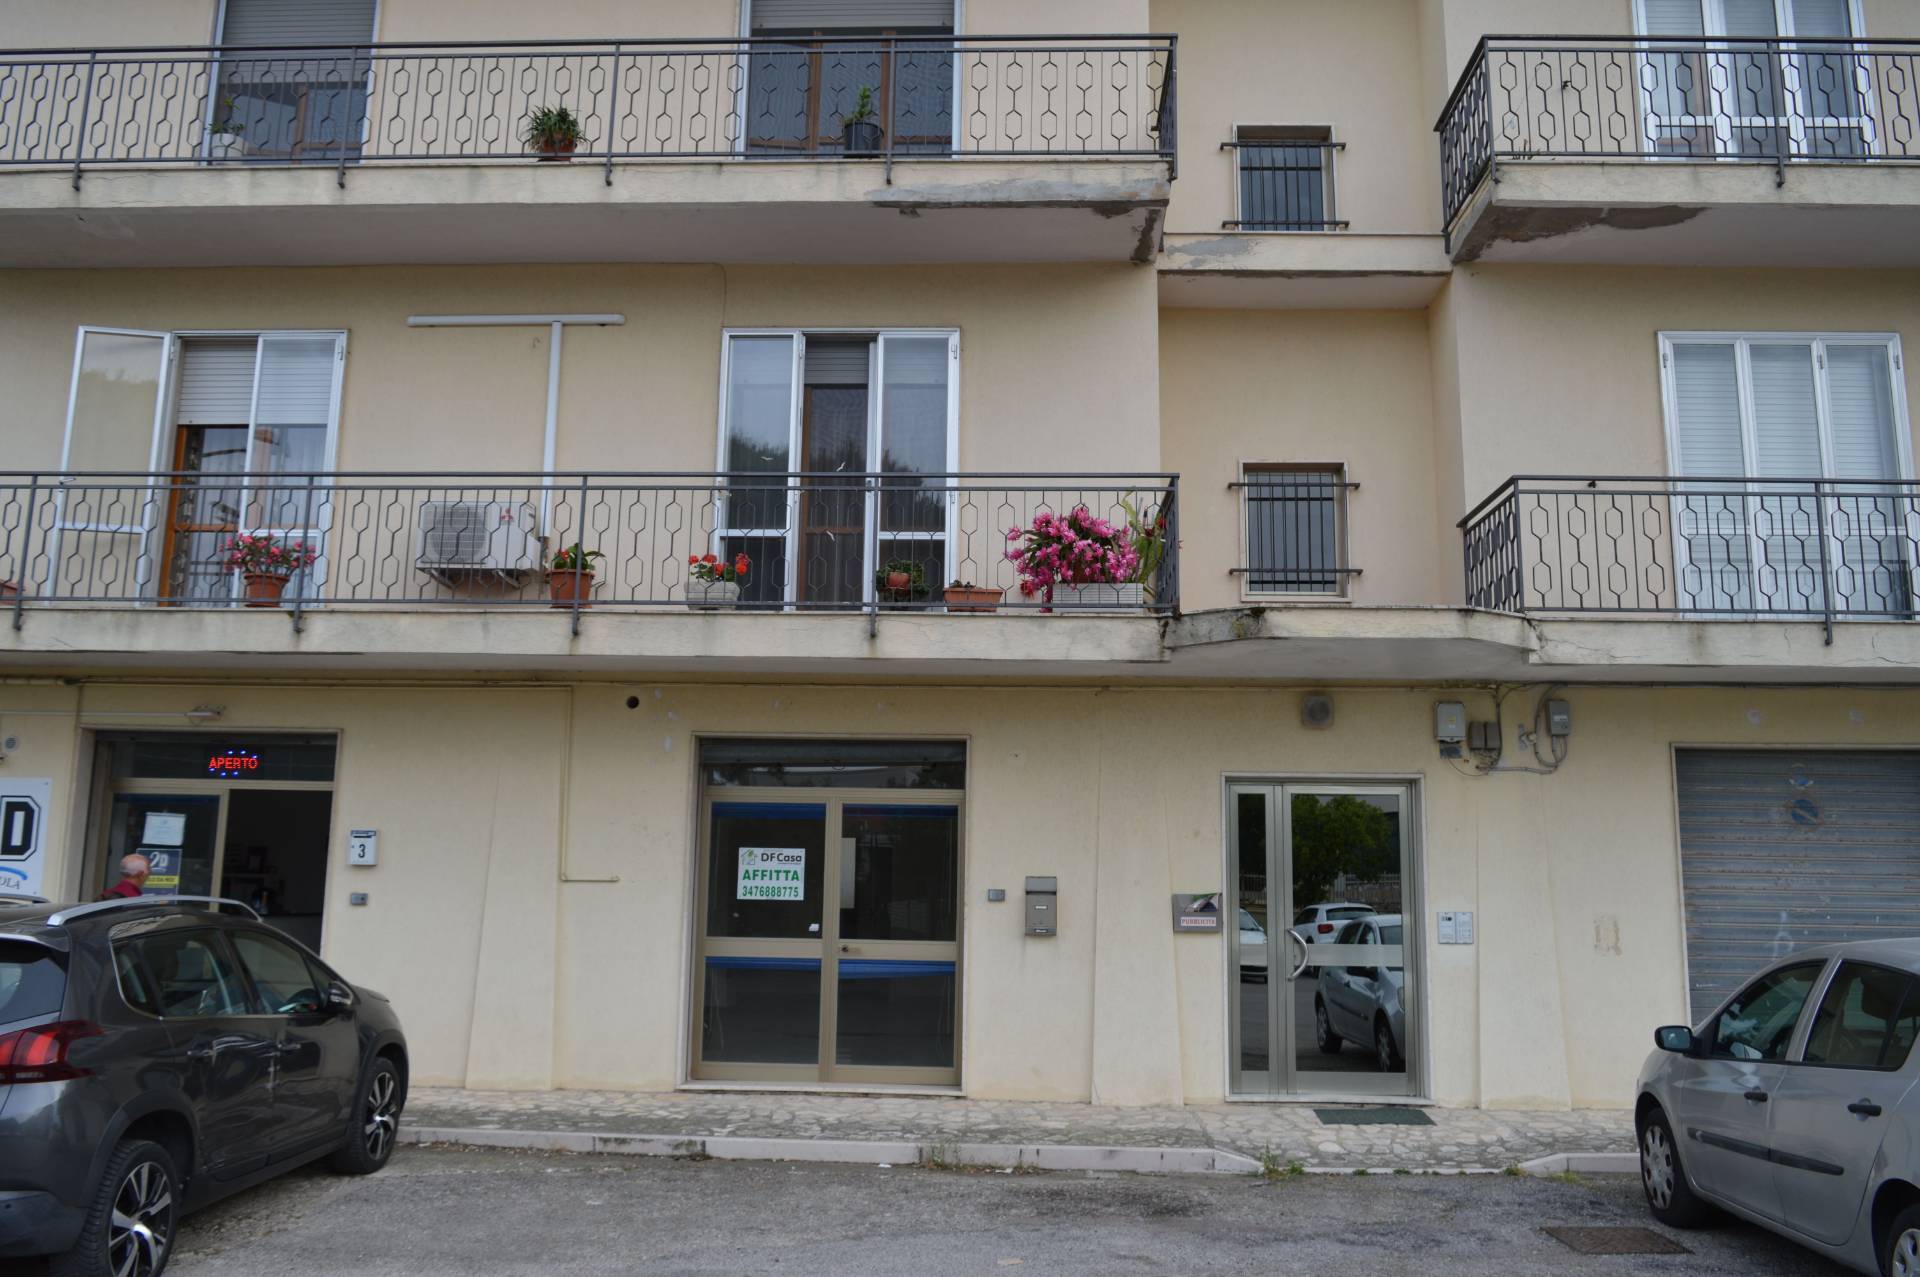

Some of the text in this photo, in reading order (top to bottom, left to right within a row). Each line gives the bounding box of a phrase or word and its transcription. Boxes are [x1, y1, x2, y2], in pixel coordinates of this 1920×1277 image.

[208, 756, 258, 769] APERTO
[358, 843, 366, 858] 3
[742, 869, 800, 881] AFFITTA
[742, 885, 799, 897] 3476888775
